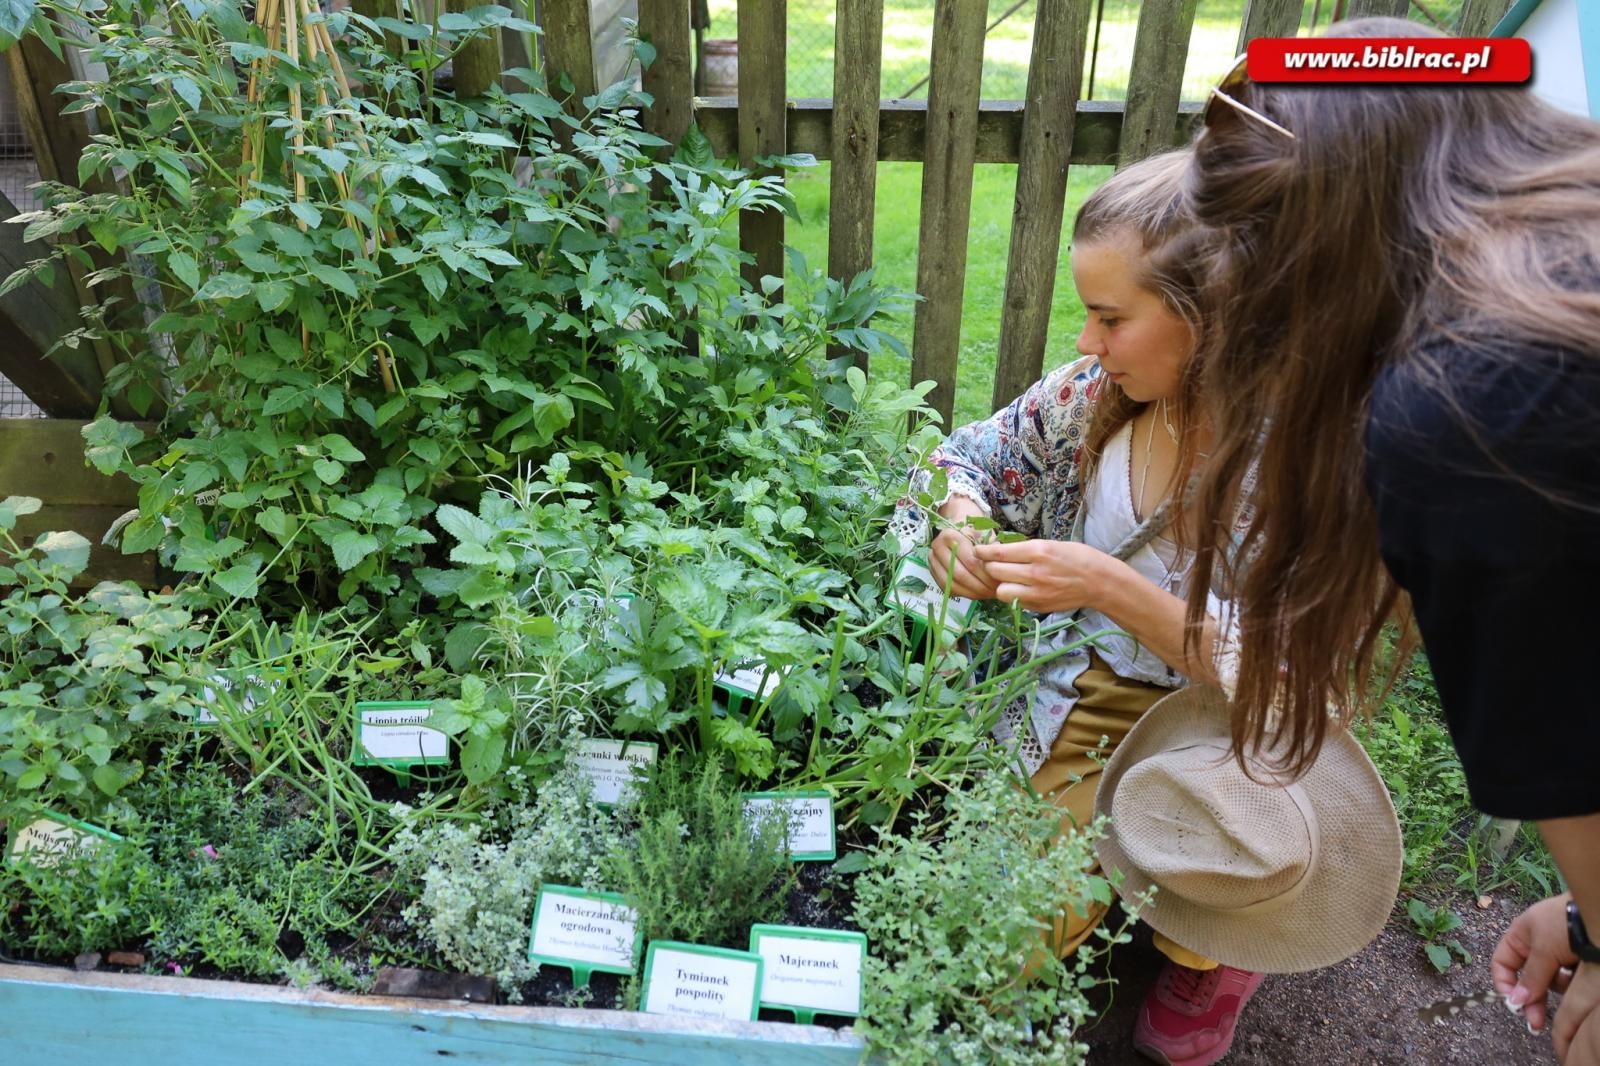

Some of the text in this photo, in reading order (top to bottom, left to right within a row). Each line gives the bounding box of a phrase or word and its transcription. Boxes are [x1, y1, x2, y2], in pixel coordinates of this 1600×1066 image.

[560, 920, 612, 936] ogrodowa
[779, 954, 839, 969] Majeranek
[676, 968, 729, 986] Tymianek
[674, 986, 725, 1004] pospolity
